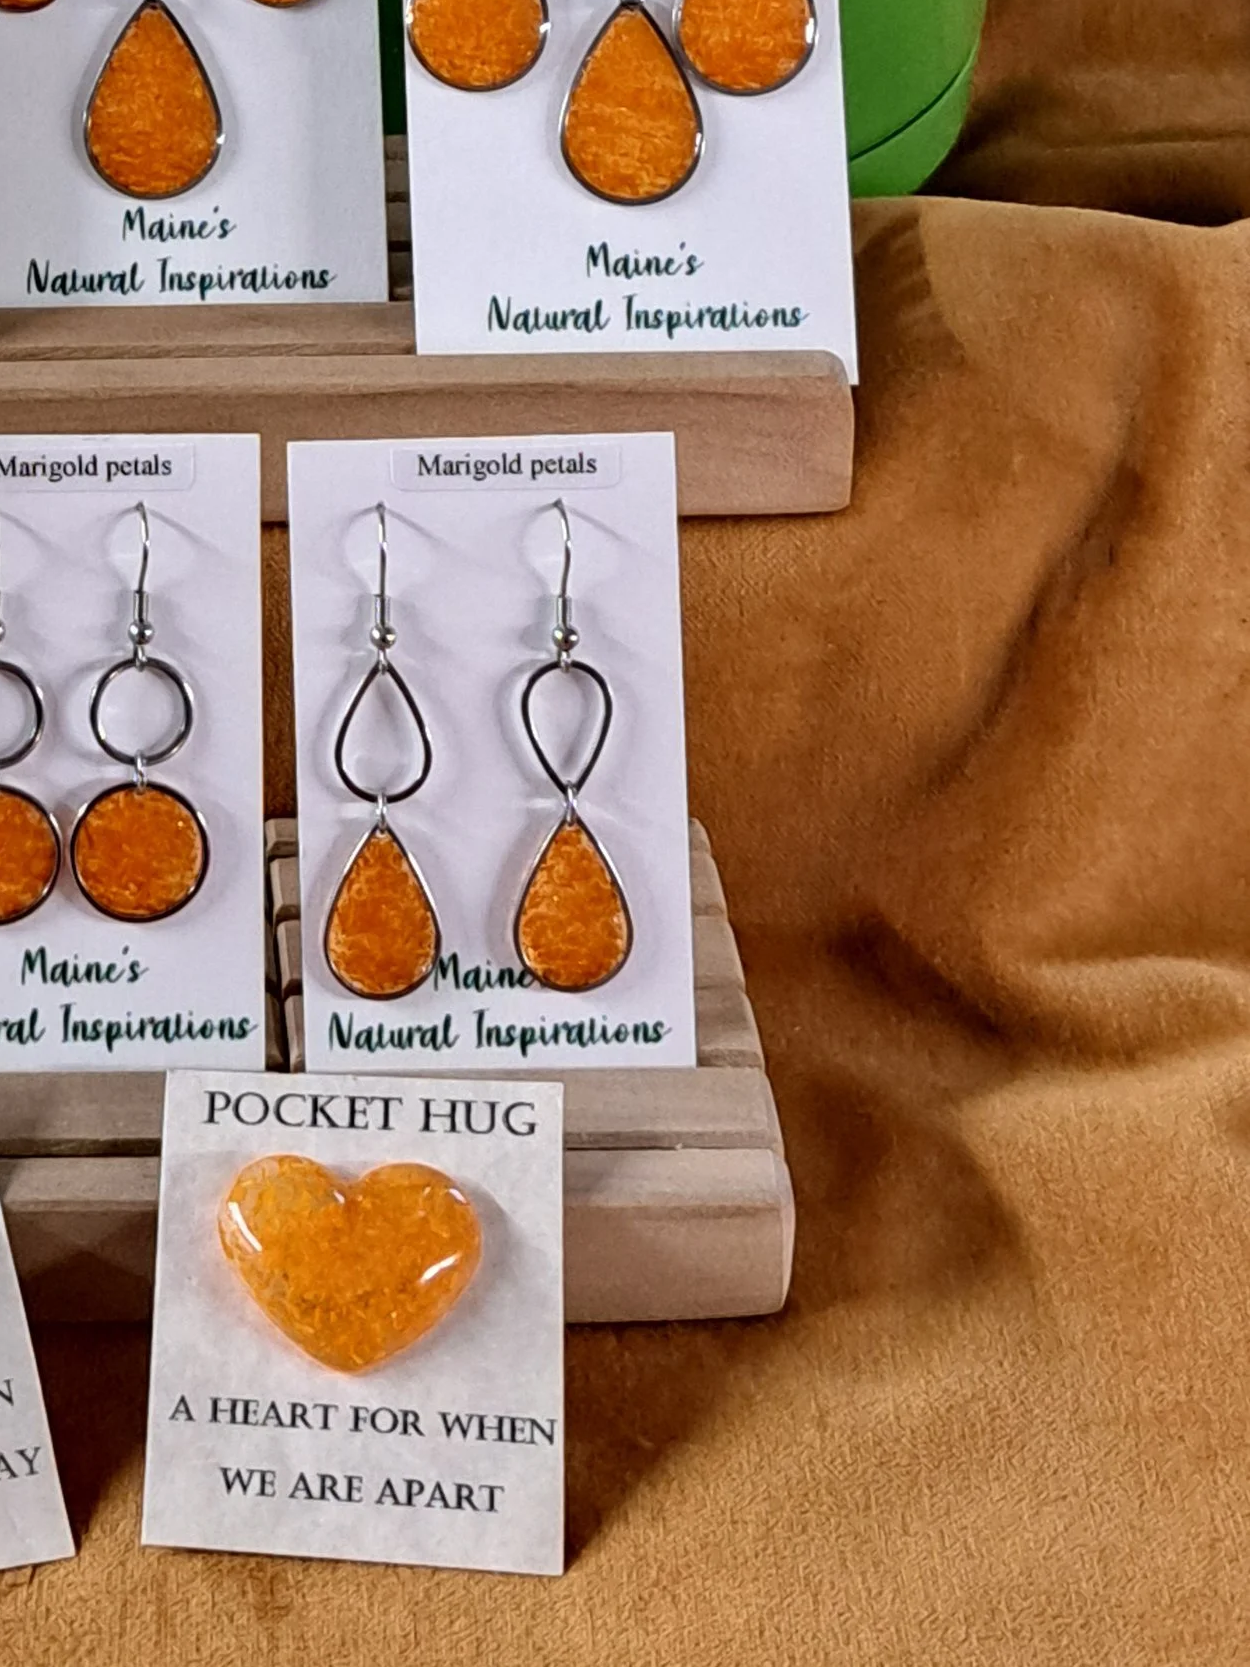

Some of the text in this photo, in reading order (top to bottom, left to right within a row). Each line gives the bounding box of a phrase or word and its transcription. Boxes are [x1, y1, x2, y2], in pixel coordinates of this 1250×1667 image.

[123, 207, 234, 242] Maine's
[27, 258, 335, 300] Natural Inspirations
[587, 242, 701, 279] Maine's
[488, 295, 806, 339] Natural Inspirations
[107, 455, 171, 482] petals
[419, 453, 597, 481] Marigold petals
[22, 947, 148, 987] Maine's
[433, 953, 538, 992] Maine
[63, 1004, 257, 1050] Inspirations
[329, 1009, 670, 1056] Natural Inspirations
[205, 1092, 536, 1136] POCKET HUG
[169, 1395, 555, 1445] A HEART FOR WHEN
[220, 1468, 504, 1512] WE ARE APART
